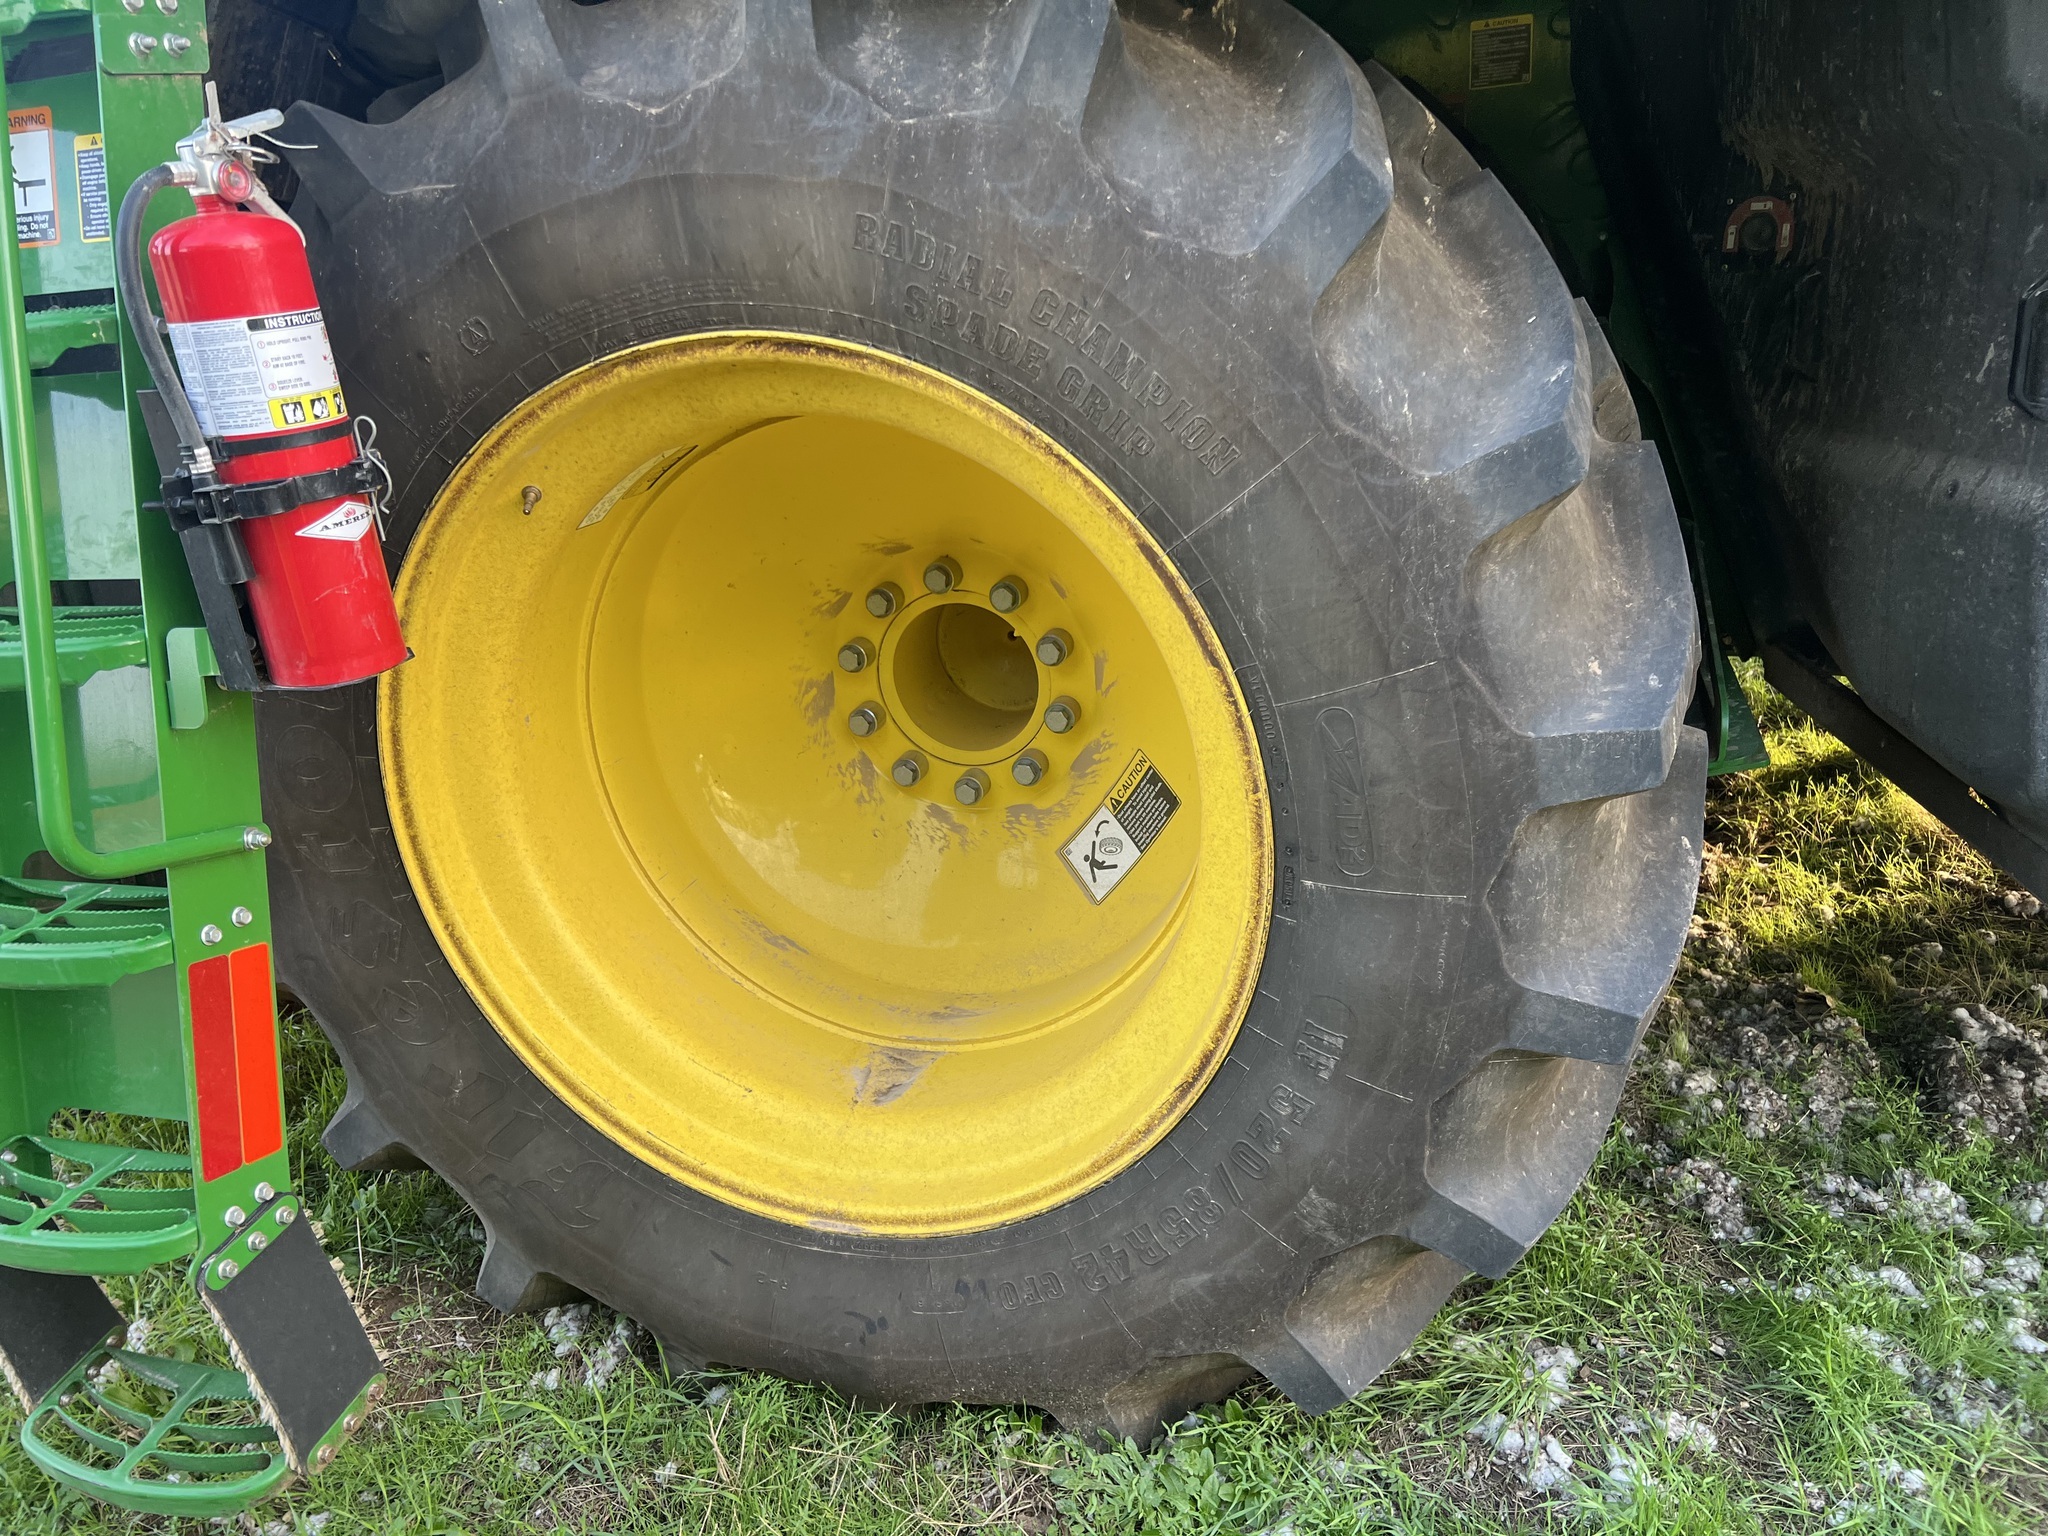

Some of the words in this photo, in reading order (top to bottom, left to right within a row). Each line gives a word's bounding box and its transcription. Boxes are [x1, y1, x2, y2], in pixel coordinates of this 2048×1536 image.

[1492, 18, 1519, 27] CAUTION
[8, 113, 46, 127] ARNING
[17, 213, 33, 223] erious
[851, 211, 1014, 310] RADIAL
[1027, 288, 1242, 477] CHAMPION
[902, 284, 1051, 382] SPADE
[1056, 365, 1157, 459] GRIP
[320, 509, 371, 531] AMEREX
[1117, 755, 1148, 800] CAUTION
[1070, 1083, 1316, 1293] 520/85R42
[998, 1270, 1066, 1312] CFO
